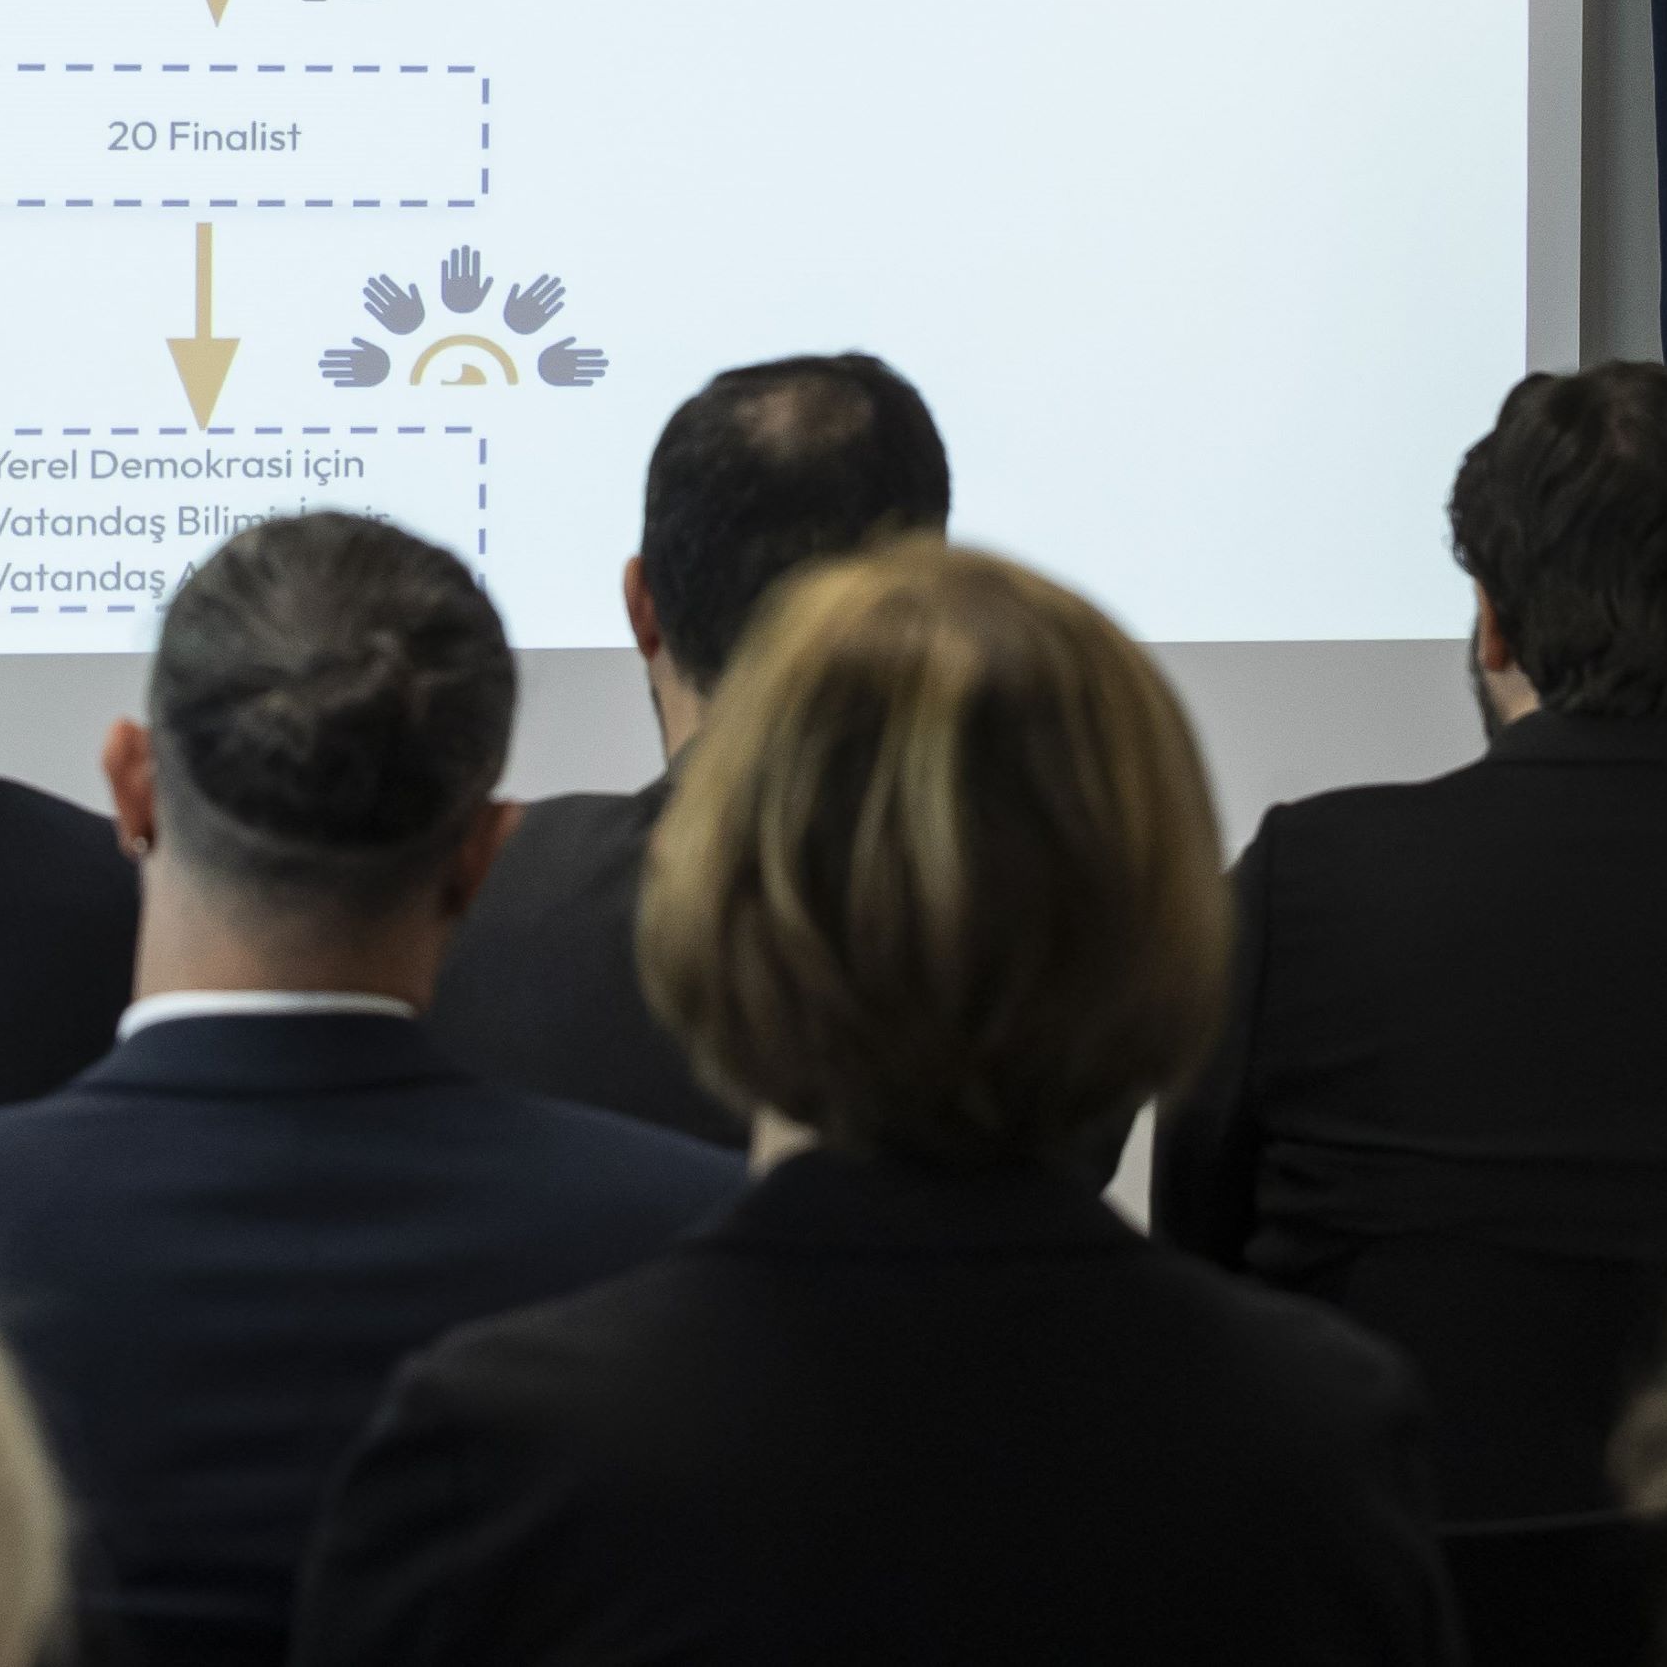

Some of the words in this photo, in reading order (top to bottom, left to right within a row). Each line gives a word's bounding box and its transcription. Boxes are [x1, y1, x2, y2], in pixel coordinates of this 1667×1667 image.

[107, 120, 158, 152] 20
[170, 120, 302, 152] Finalist
[90, 448, 293, 481] Demokrasi
[304, 448, 365, 487] için
[177, 504, 277, 536] Bilim
